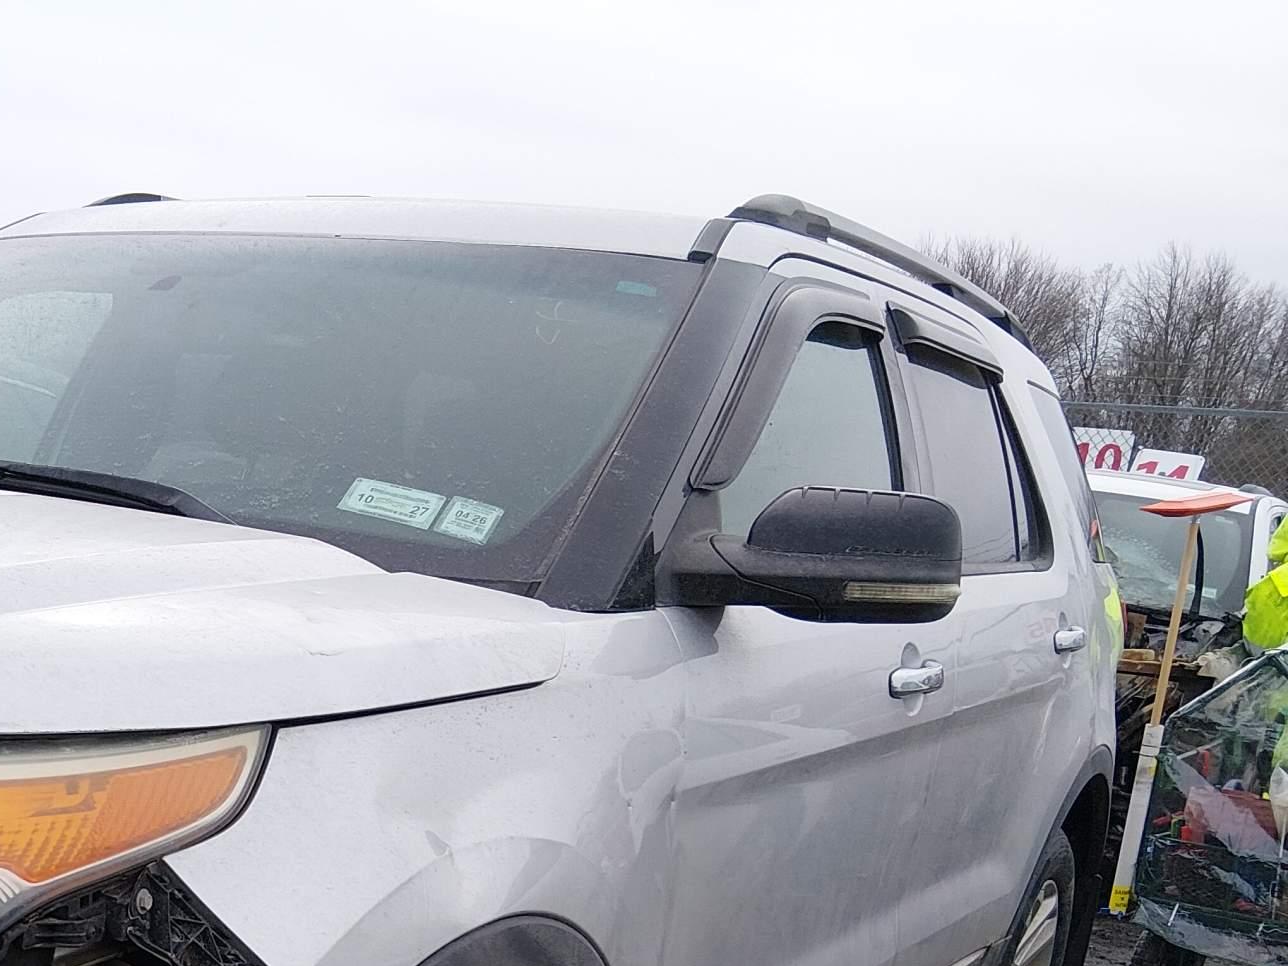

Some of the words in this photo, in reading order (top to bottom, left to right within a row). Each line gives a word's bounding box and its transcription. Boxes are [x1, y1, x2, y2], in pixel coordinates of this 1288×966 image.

[357, 493, 375, 504] 10
[409, 505, 430, 518] 27
[455, 509, 470, 520] 04
[473, 514, 488, 525] 26
